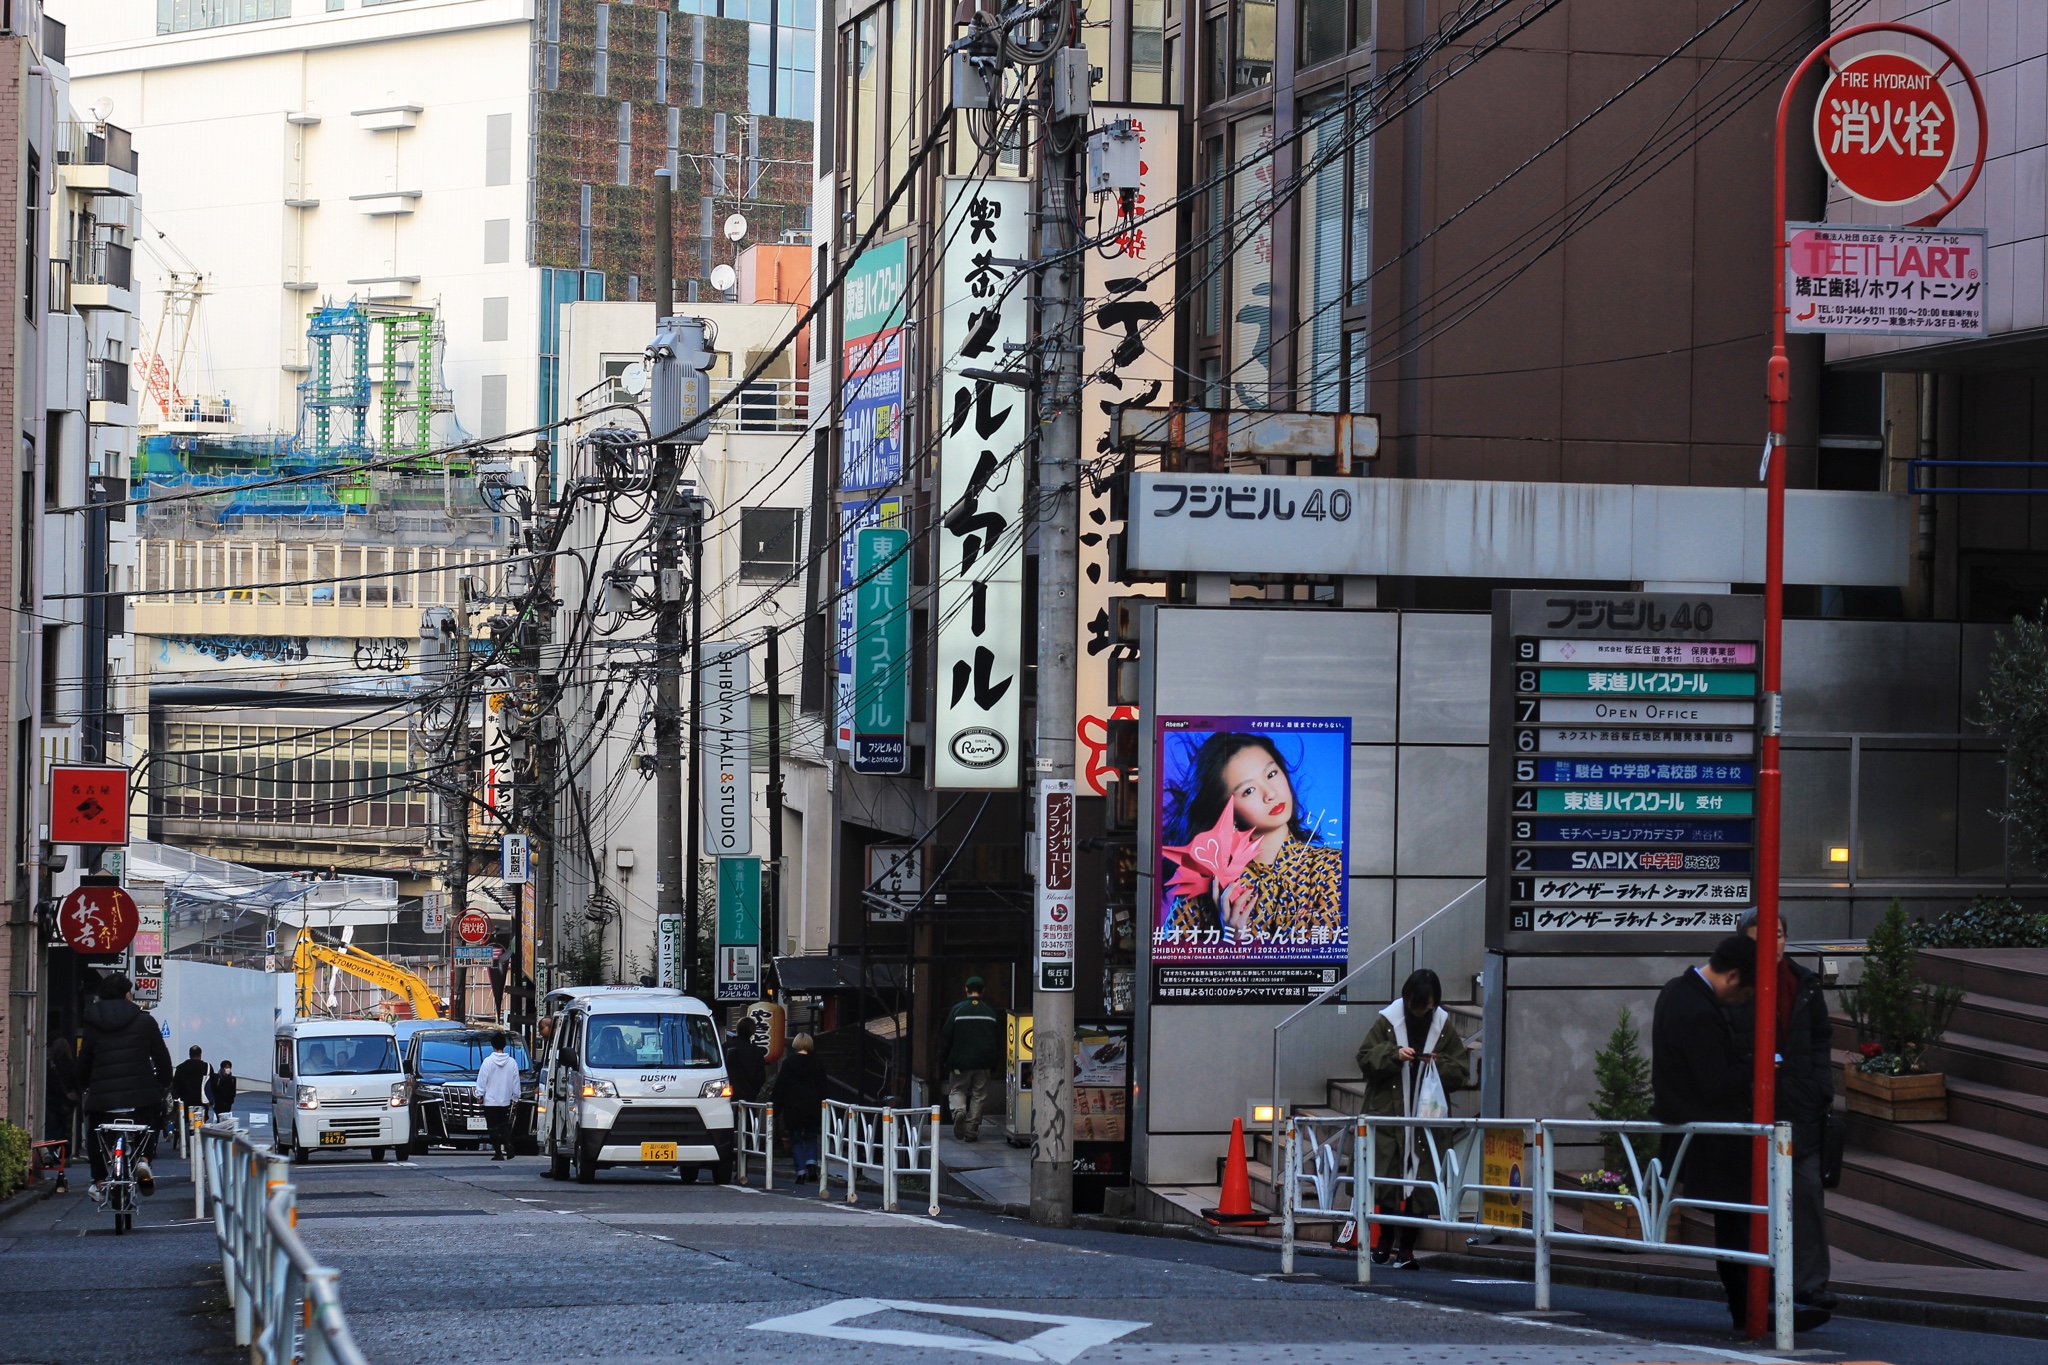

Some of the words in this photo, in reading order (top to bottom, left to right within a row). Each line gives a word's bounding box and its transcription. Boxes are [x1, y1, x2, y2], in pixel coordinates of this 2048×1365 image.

[1841, 72, 1869, 88] FIRE
[1874, 74, 1932, 90] HYDRANT
[1830, 98, 1946, 157] 消火栓
[1814, 232, 1860, 241] 医療法人社団
[1804, 242, 1971, 279] TEETHART
[846, 262, 903, 322] 東進ハイスクール
[1795, 276, 1981, 301] 矯正歯科/ホワイトニング
[684, 394, 697, 404] 50
[682, 407, 698, 416] 125
[868, 536, 894, 728] 東進ハイスクール
[1520, 642, 1534, 659] 9
[1598, 645, 1622, 653] 株式会社
[1625, 644, 1661, 656] 桜丘住販
[1664, 645, 1682, 656] 本社
[1691, 646, 1736, 657] 保険事業部
[718, 650, 734, 725] SHIBUYA
[1519, 671, 1536, 691] 8
[1587, 672, 1708, 693] 東進ハイスクール
[1519, 700, 1536, 722] 7
[1518, 730, 1534, 751] 6
[1558, 731, 1598, 742] ネクスト
[1517, 760, 1534, 781] 5
[1575, 764, 1604, 779] 駿台
[1609, 764, 1698, 779] 中学部・高校部
[1701, 766, 1742, 779] 渋谷校
[1516, 791, 1533, 809] 4
[1563, 791, 1685, 811] 東進ハイスクール
[1696, 795, 1723, 810] 受付
[1061, 795, 1072, 878] ネイルサロン
[1516, 822, 1531, 838] 3
[1559, 828, 1685, 840] モチベーションアカデミア
[1691, 829, 1724, 841] 渋谷校
[1515, 849, 1532, 870] 2
[1571, 851, 1639, 869] SAPIX
[1639, 852, 1684, 869] 中学部
[1684, 855, 1720, 870] 渋谷校
[1517, 881, 1525, 898] 1
[1616, 883, 1661, 899] ラケット
[1710, 885, 1748, 898] 渋谷店
[734, 860, 745, 940] 東進ハイスクール
[461, 922, 485, 934] 消火栓
[1514, 911, 1529, 928] B1
[1613, 912, 1659, 928] ラケット
[1152, 925, 1348, 946] #オオカミちゃんは誰だ
[336, 958, 375, 977] TOMOYAMA
[1047, 969, 1069, 977] 桜丘町
[1053, 978, 1064, 986] 15
[650, 1150, 674, 1160] 16-51
